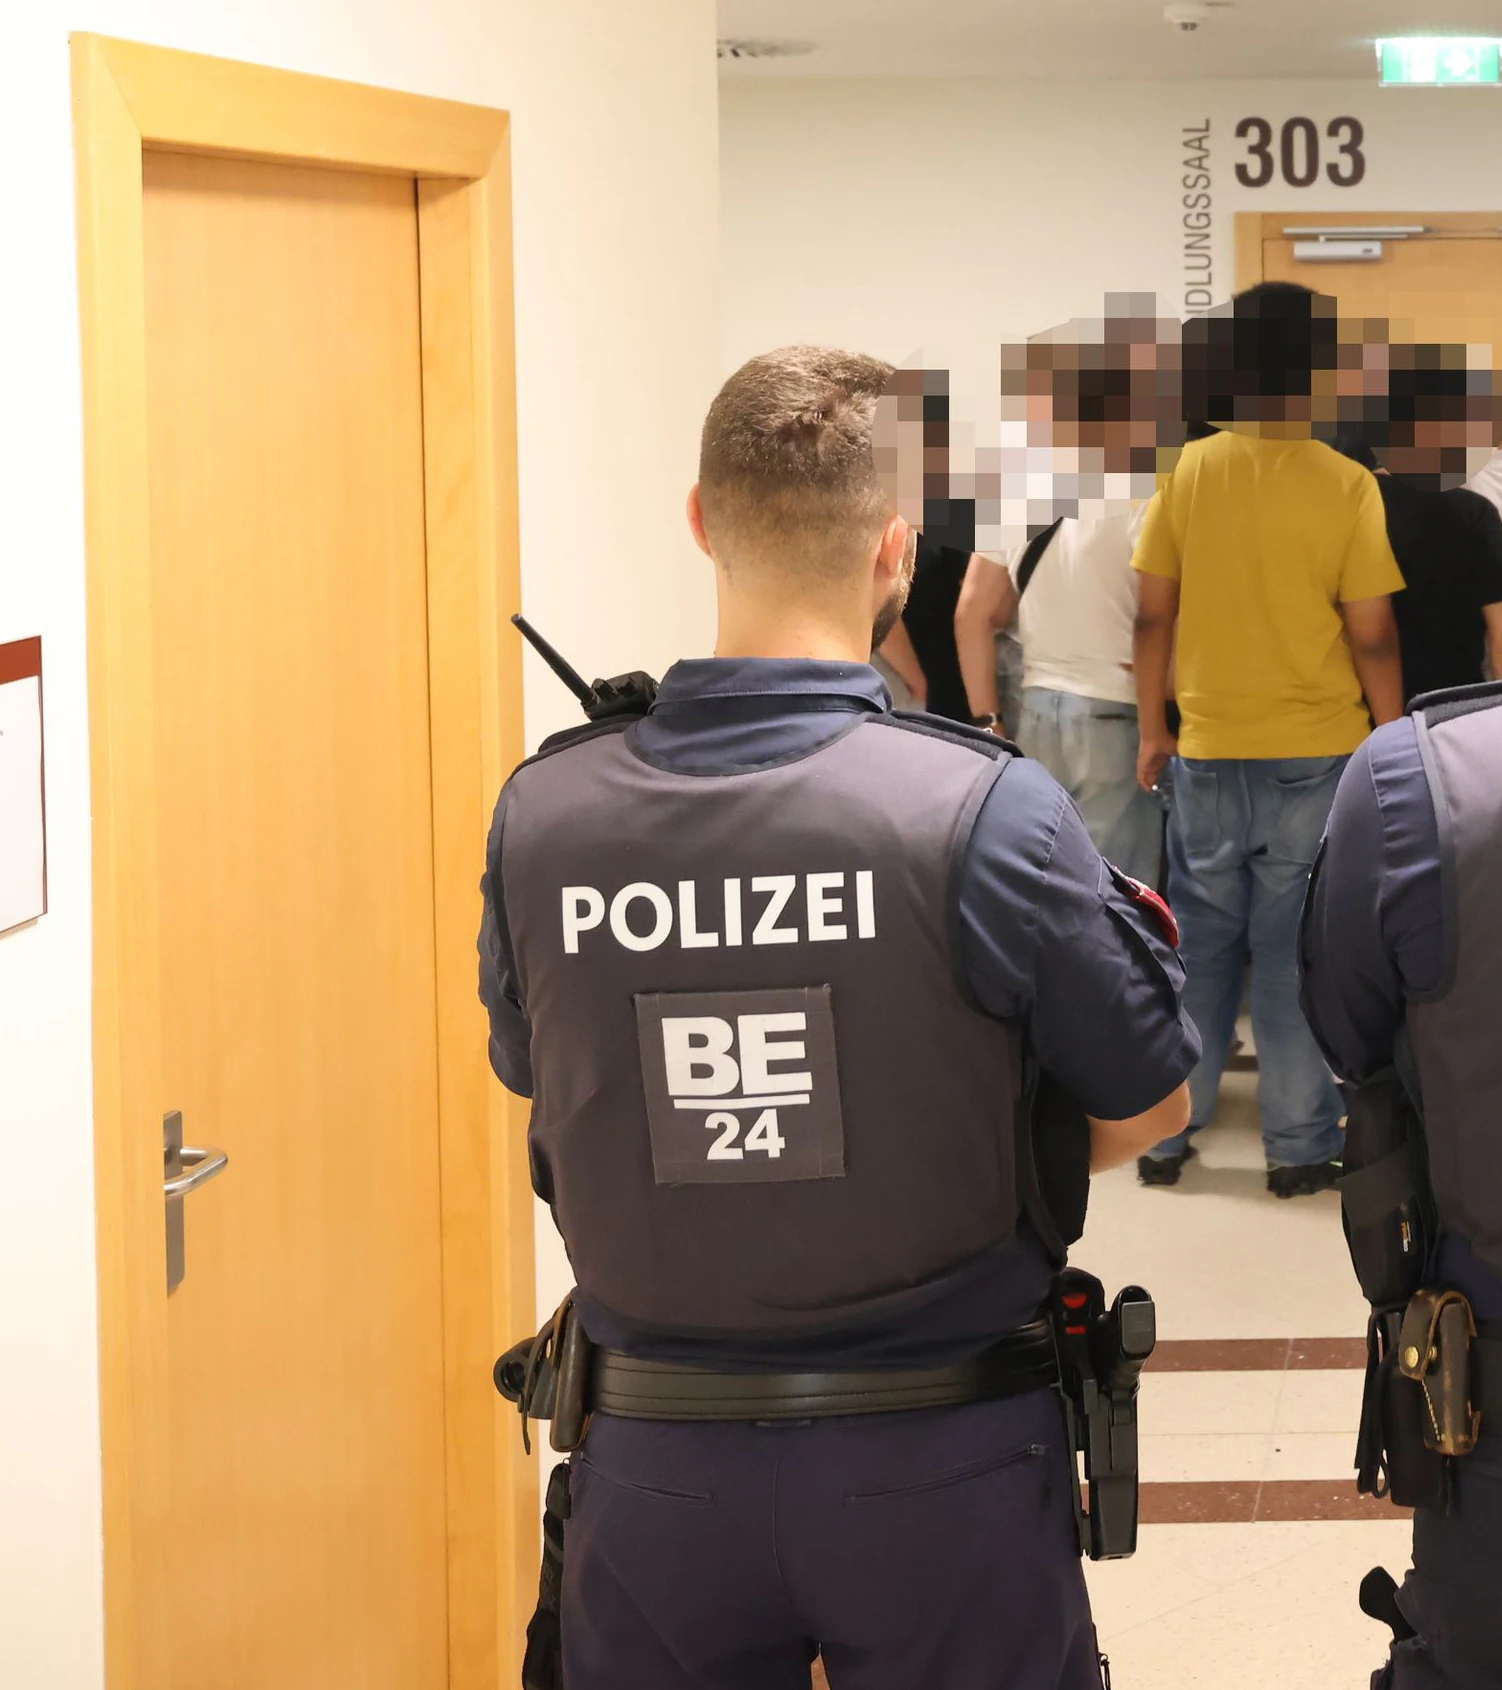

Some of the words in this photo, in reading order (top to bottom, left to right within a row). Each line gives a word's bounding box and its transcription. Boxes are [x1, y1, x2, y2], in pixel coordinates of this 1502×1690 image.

[1234, 116, 1366, 188] 303
[1182, 118, 1213, 315] DLUNGSSAAL
[562, 871, 875, 953] POLIZEI
[662, 1012, 812, 1098] BE
[705, 1109, 786, 1161] 24
